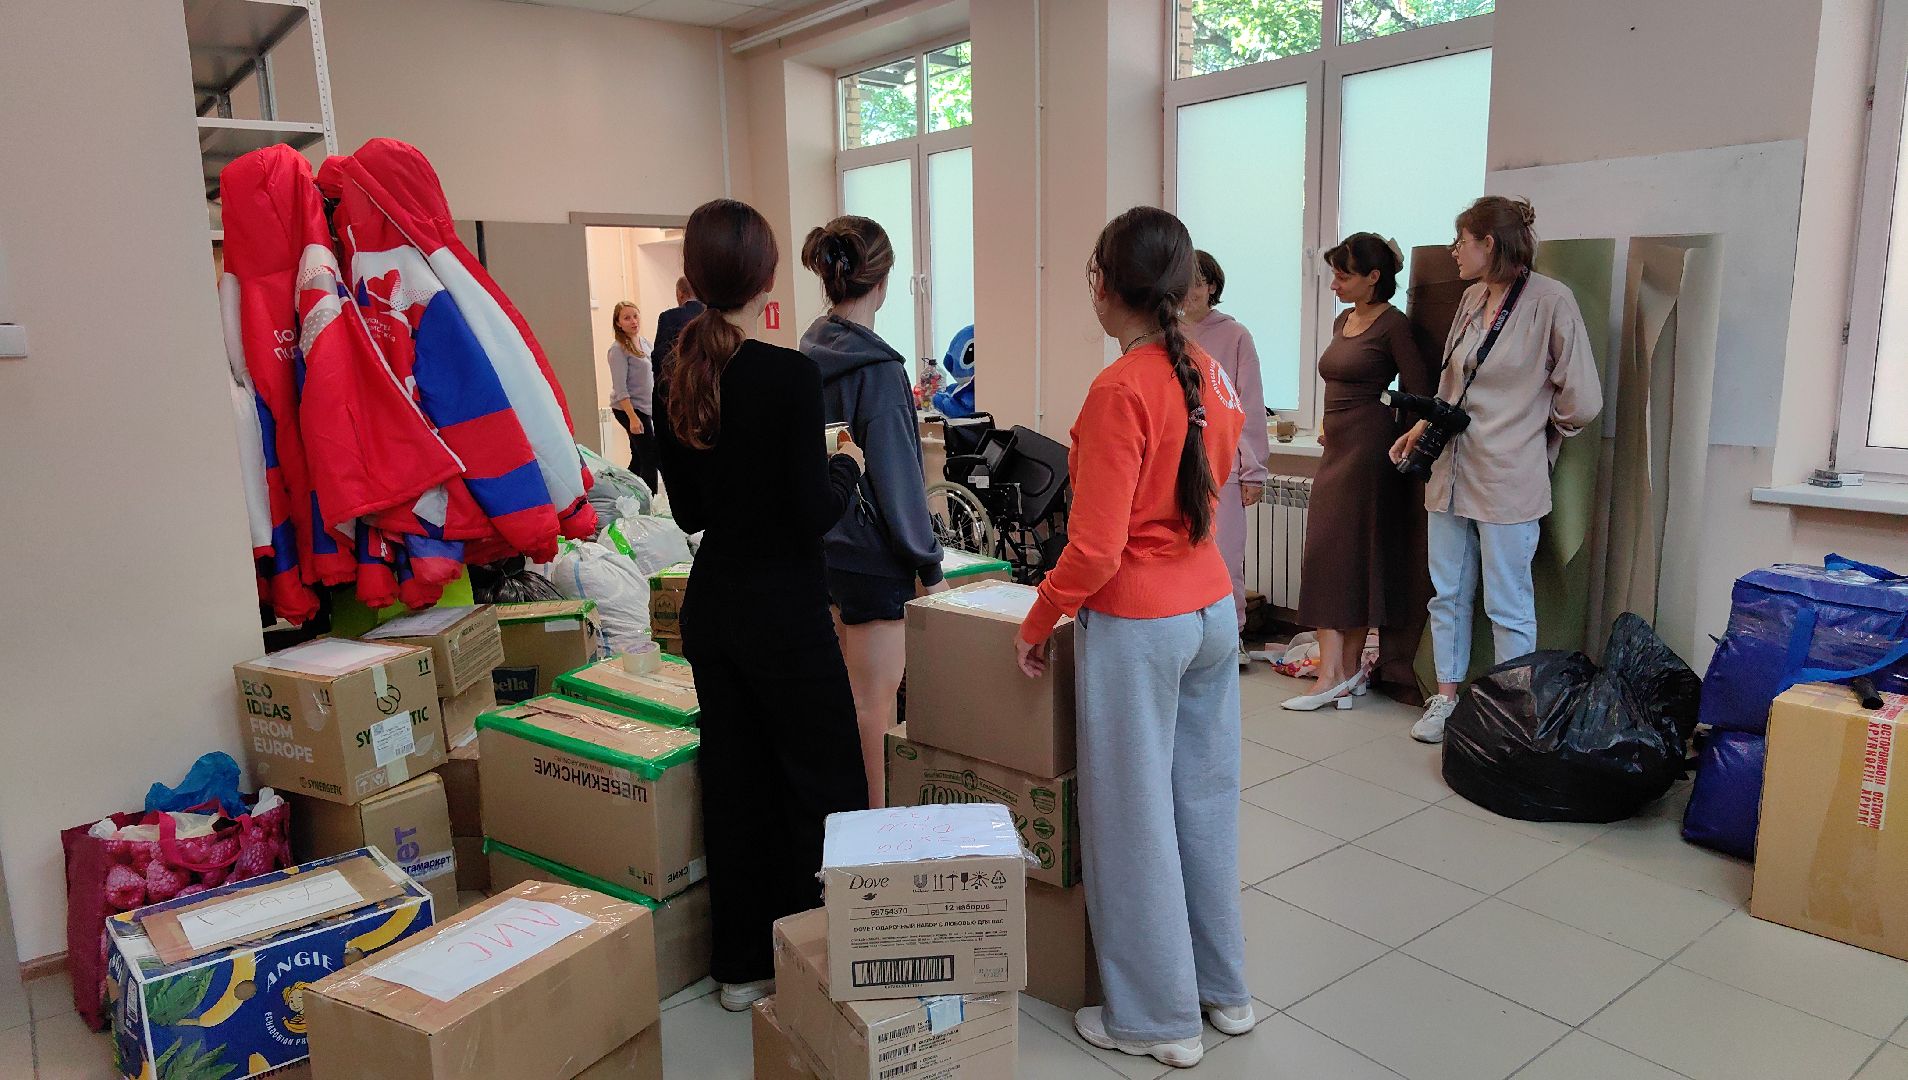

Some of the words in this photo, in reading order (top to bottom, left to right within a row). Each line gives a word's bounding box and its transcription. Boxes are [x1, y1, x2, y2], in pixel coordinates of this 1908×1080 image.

[242, 680, 272, 699] ECO
[246, 698, 292, 722] IDEAS
[250, 718, 294, 740] FROM
[253, 736, 314, 763] EUROPE
[307, 778, 343, 796] SYNERGETIC
[533, 757, 648, 803] ШЕБЕКИНСКИЕ
[402, 855, 452, 875] егамаркет
[849, 875, 889, 890] Dove
[266, 950, 334, 993] ANGIE
[264, 1011, 294, 1046] ECUADORIAN
